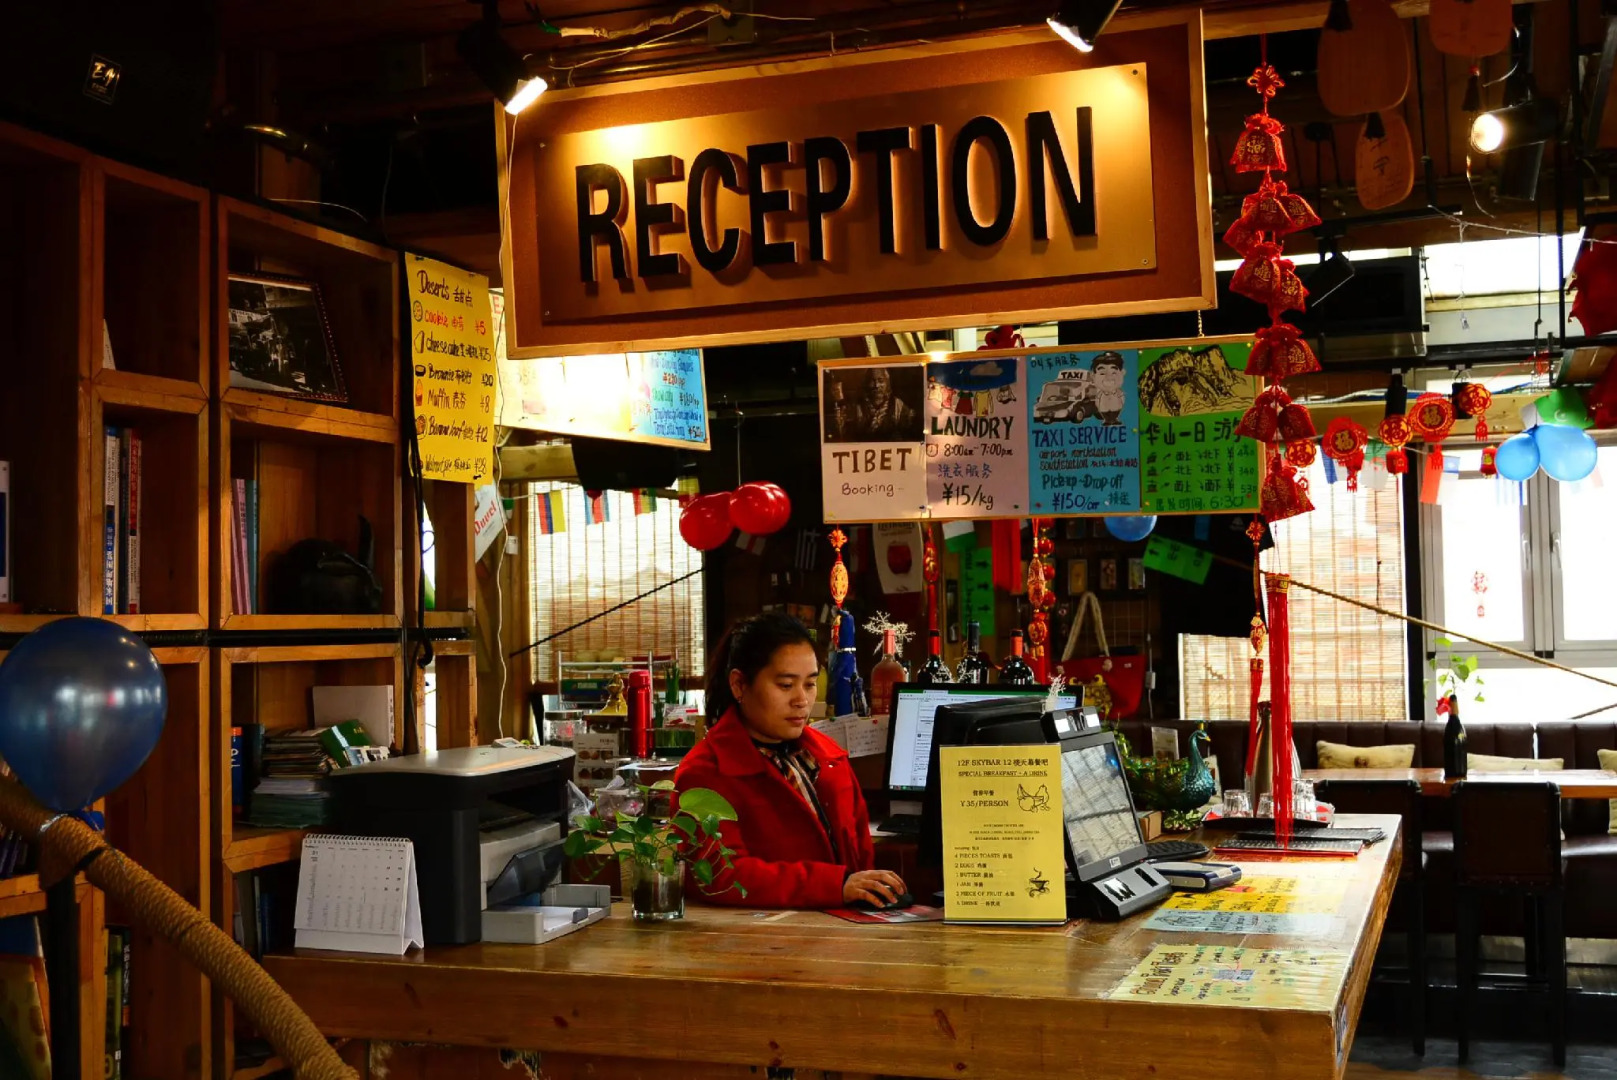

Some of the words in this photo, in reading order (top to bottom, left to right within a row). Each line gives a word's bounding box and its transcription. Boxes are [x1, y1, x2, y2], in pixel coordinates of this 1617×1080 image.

[575, 105, 1098, 284] RECEPTION
[1060, 370, 1084, 380] TAXI
[427, 388, 451, 409] Muffin
[931, 416, 1015, 440] LAUNDRY
[1032, 428, 1065, 448] TAXI
[1068, 426, 1127, 445] SERVICE
[832, 447, 913, 474] TIBET
[937, 463, 993, 479] 洗衣服务
[841, 482, 895, 497] Booking
[942, 482, 994, 511] ¥15/kg
[972, 758, 1001, 766] SKYBAR
[958, 770, 982, 778] SPECIAL
